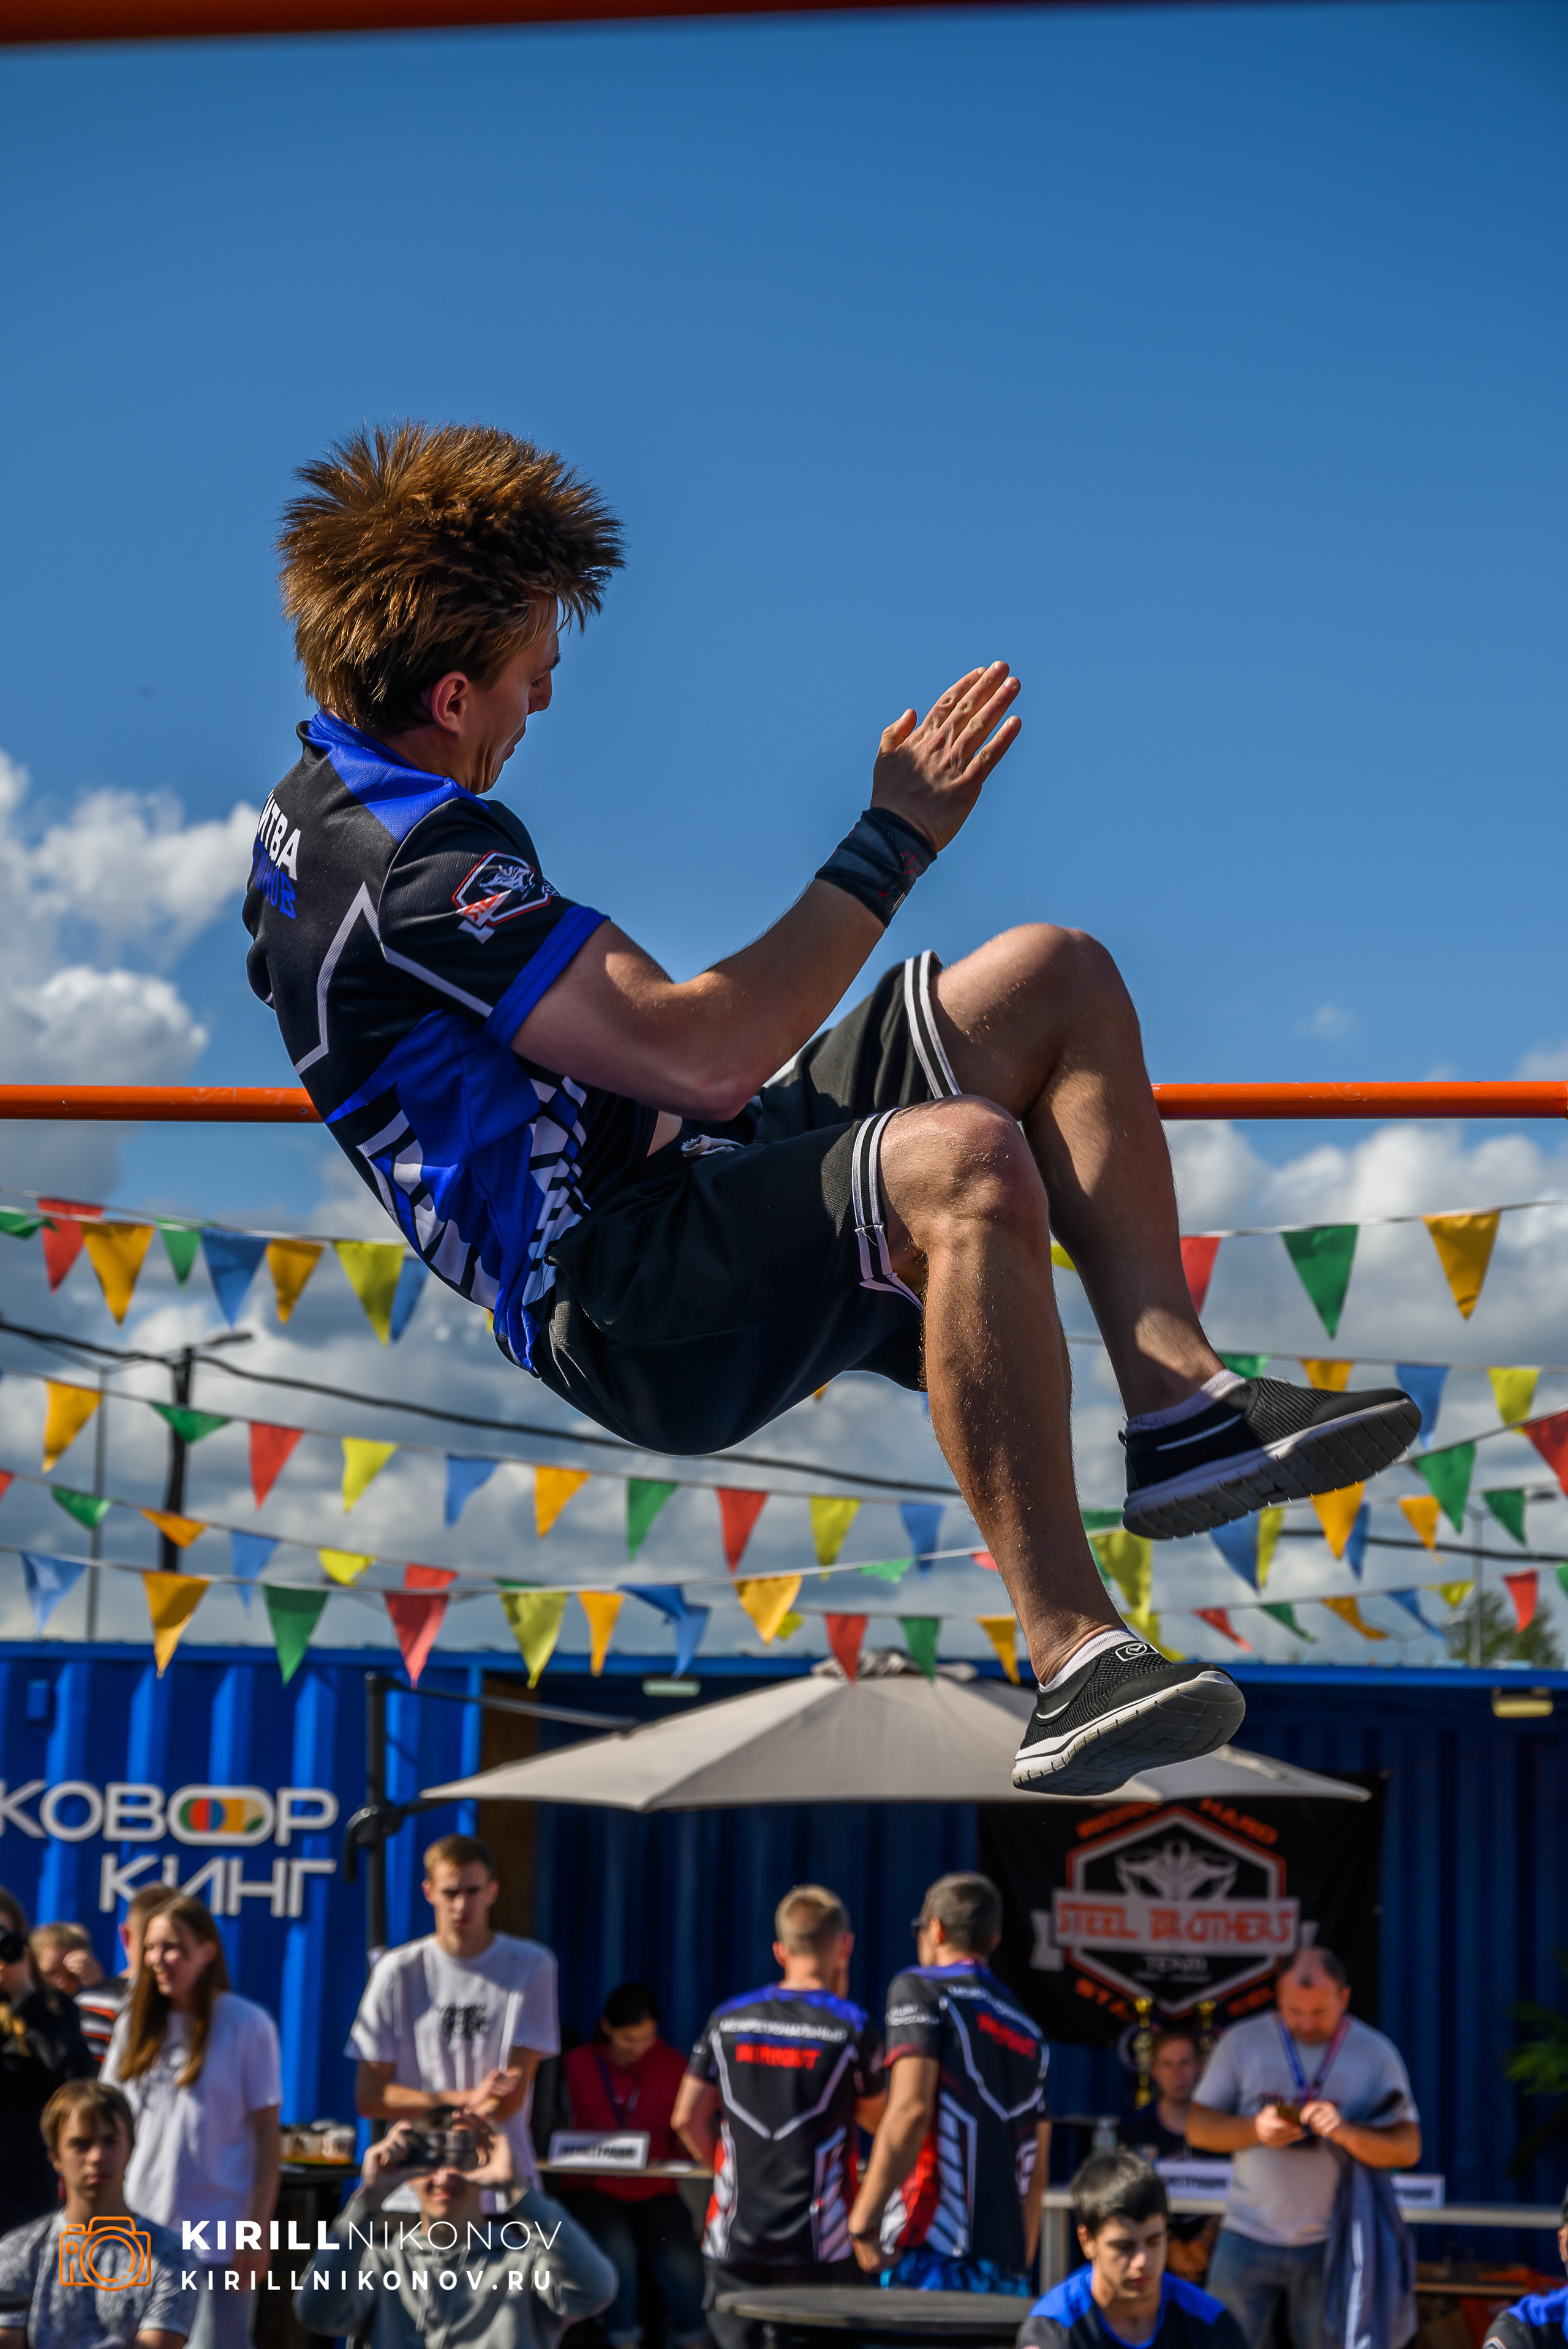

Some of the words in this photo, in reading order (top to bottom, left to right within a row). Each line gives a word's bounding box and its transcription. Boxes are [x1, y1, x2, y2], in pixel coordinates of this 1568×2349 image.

[99, 1853, 337, 1918] КИНГ
[1057, 1902, 1138, 1940] STEEL
[1148, 1908, 1295, 1944] BROTHERS
